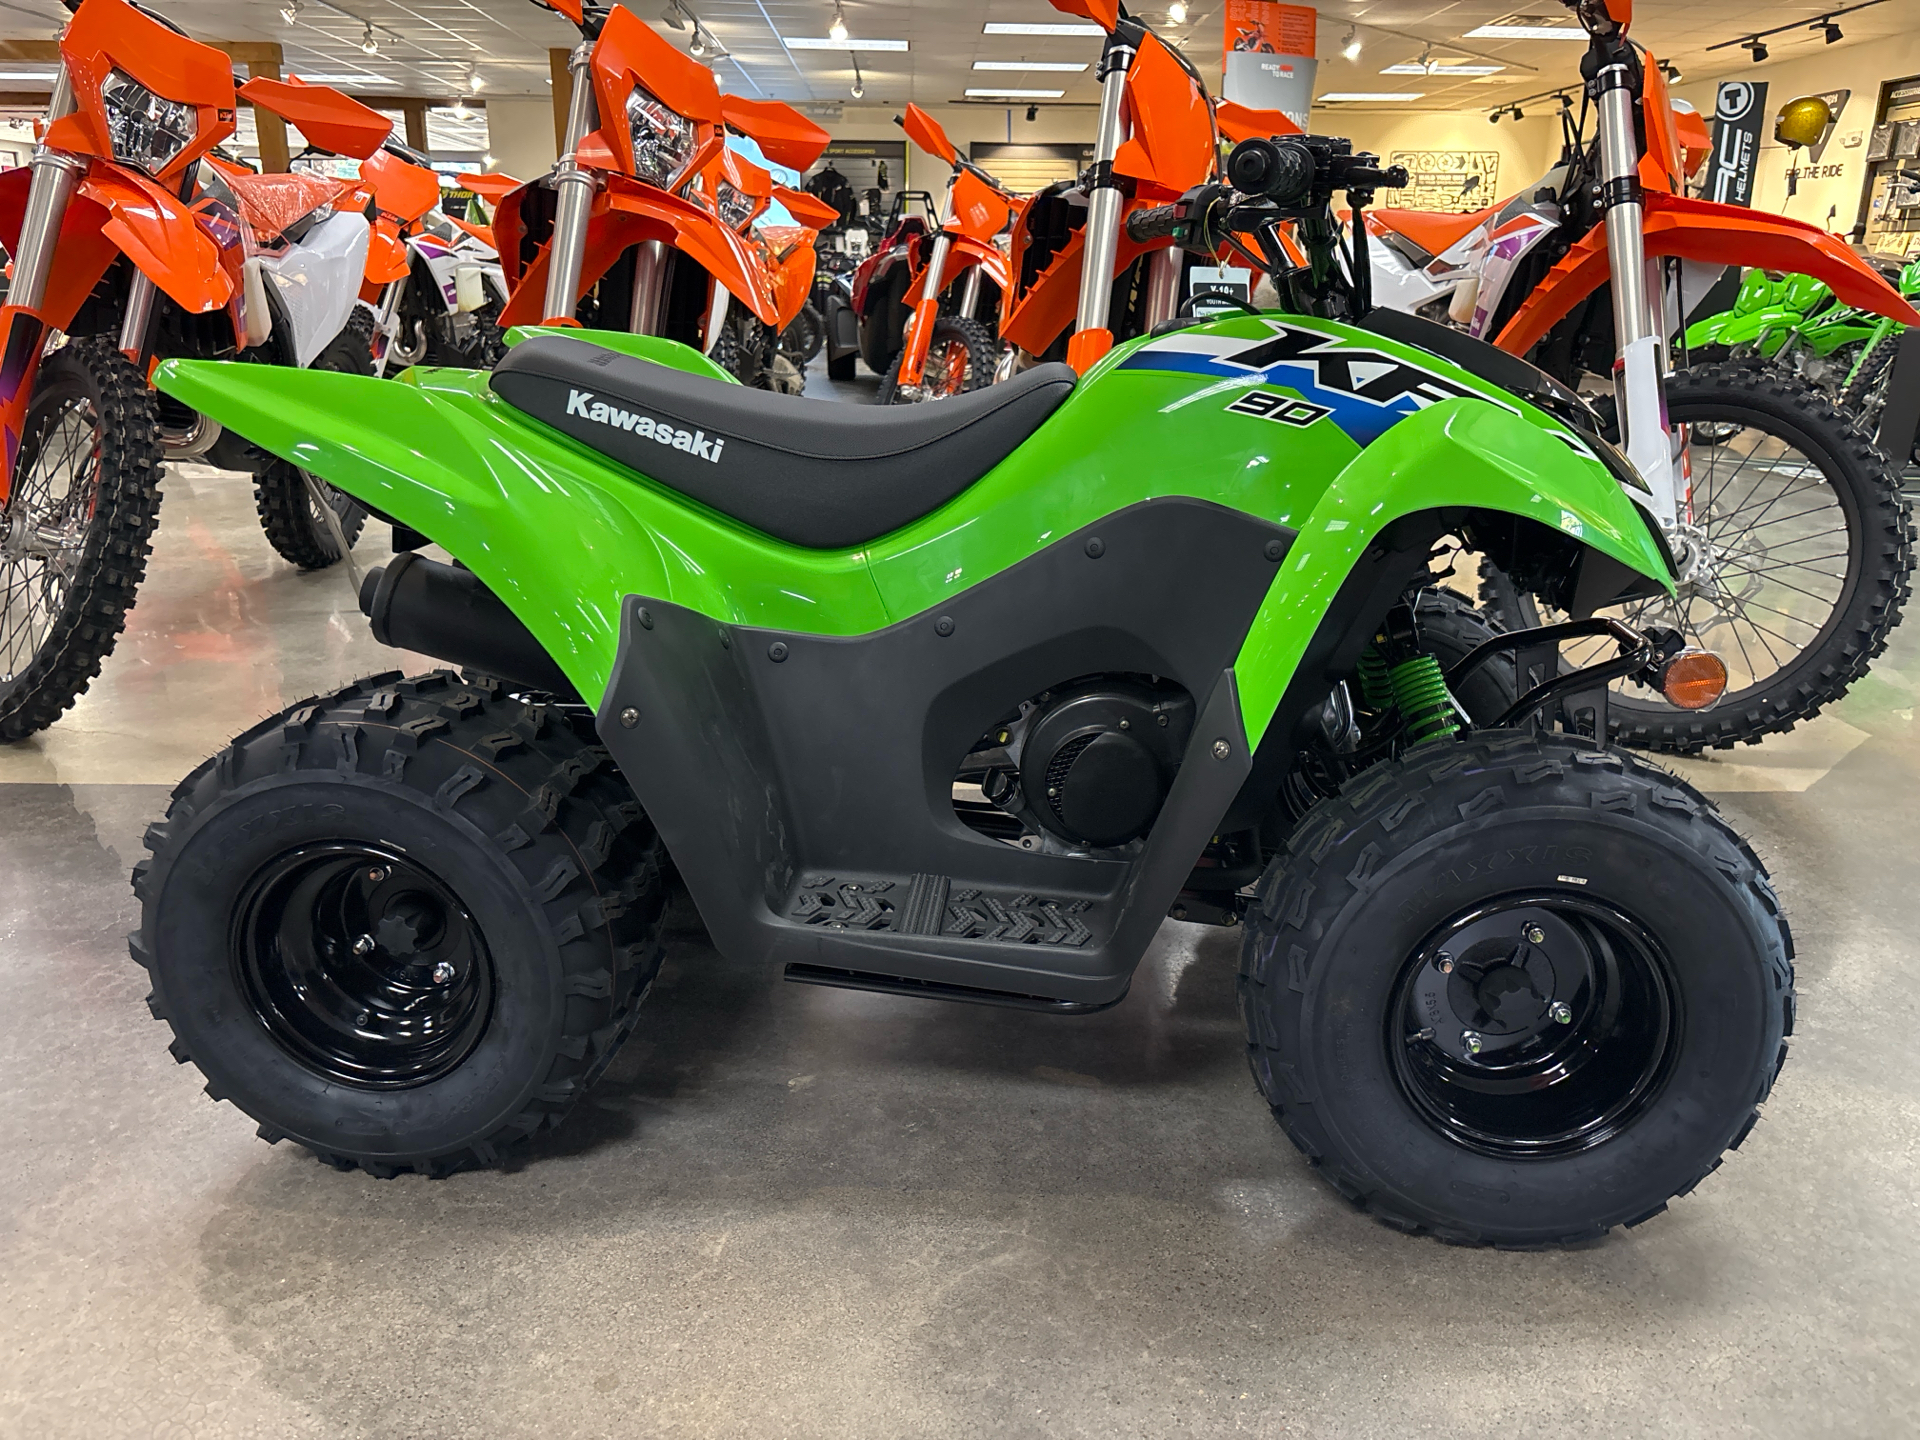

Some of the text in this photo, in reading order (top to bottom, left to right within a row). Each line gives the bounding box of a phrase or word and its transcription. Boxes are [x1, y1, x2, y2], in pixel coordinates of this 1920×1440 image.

[1261, 63, 1280, 71] READY
[1735, 131, 1753, 202] HELMETS
[1803, 166, 1820, 180] THE
[1822, 163, 1844, 178] RIDE
[449, 190, 474, 198] THOR
[1226, 391, 1335, 428] 90
[566, 389, 725, 464] Kawasaki
